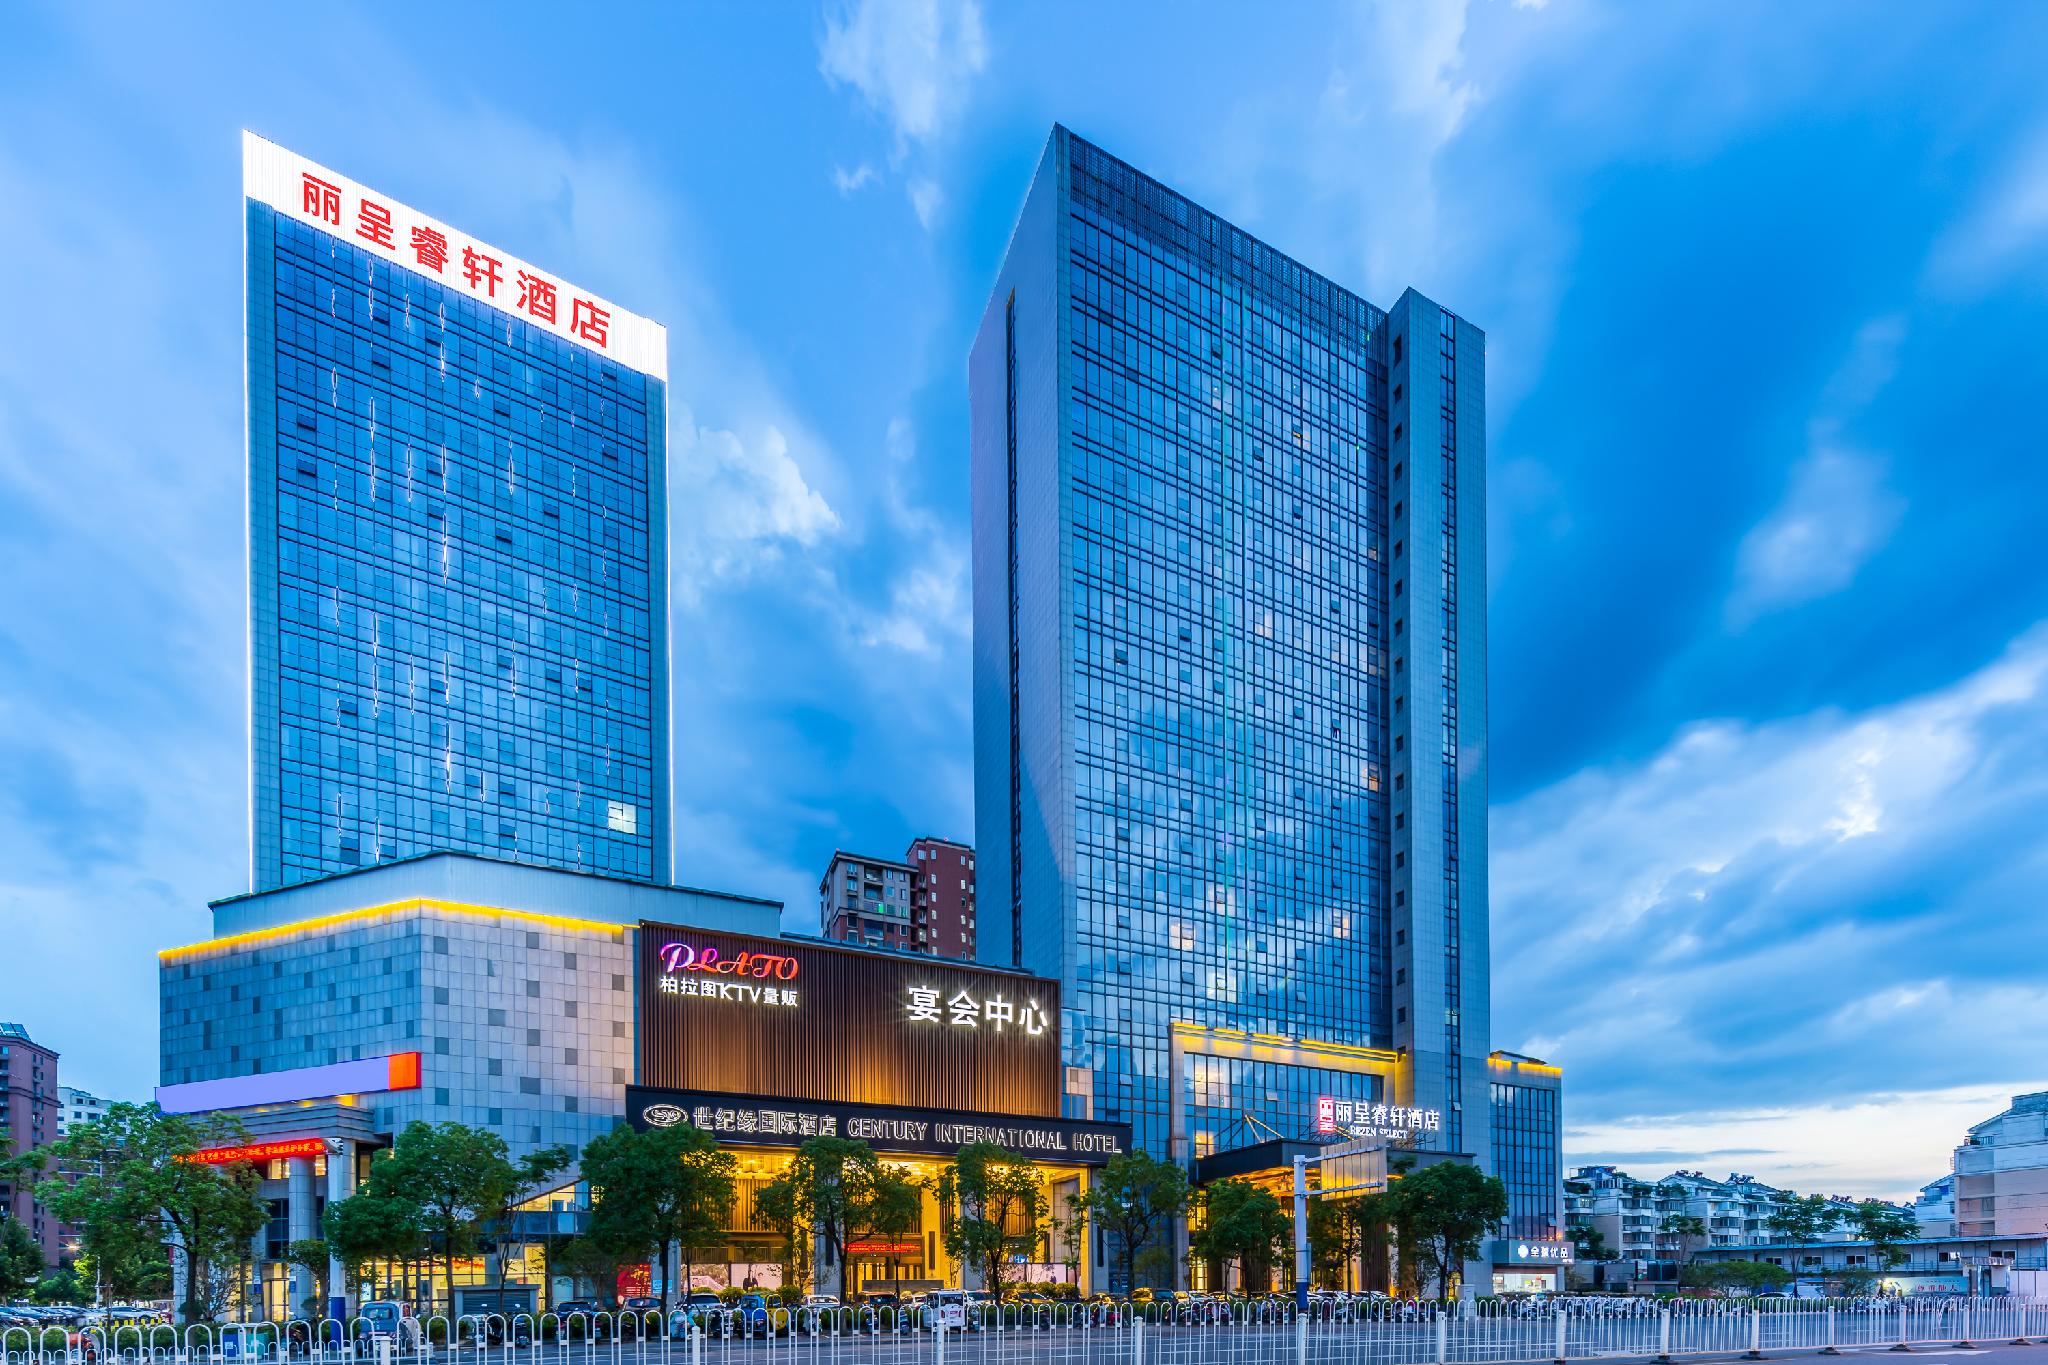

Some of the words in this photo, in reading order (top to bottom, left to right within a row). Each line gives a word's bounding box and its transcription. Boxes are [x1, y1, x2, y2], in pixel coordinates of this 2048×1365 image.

[302, 172, 611, 349] 丽呈睿轩酒店
[660, 942, 799, 980] PLATO
[660, 975, 798, 1007] 柏拉图KTV量贩
[906, 985, 1049, 1036] 宴会中心
[693, 1106, 837, 1137] 世纪缘国际酒店
[1335, 1101, 1440, 1131] 丽呈睿轩酒店
[1349, 1125, 1377, 1137] REZEN
[1379, 1128, 1408, 1139] SELECT
[848, 1117, 928, 1141] CENTURY
[934, 1123, 1067, 1150] INTERNATIONAL
[1072, 1132, 1123, 1154] HOTEL
